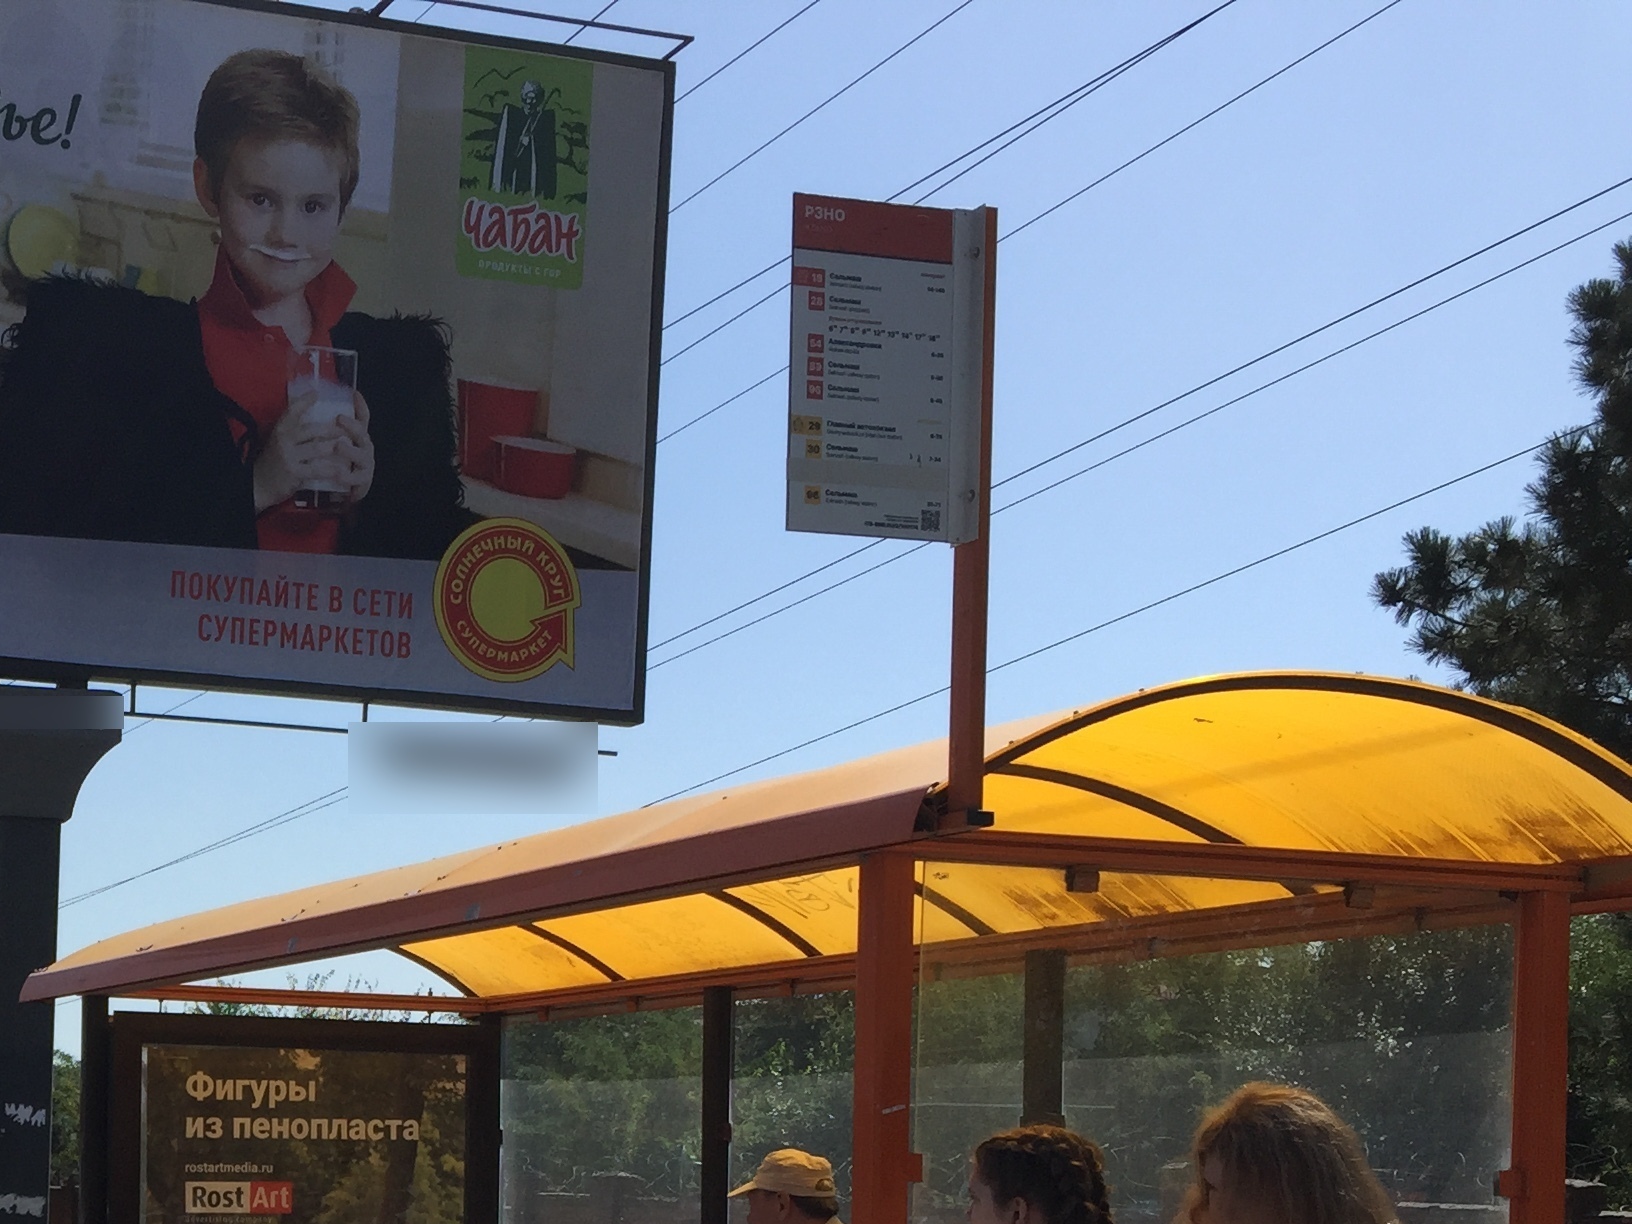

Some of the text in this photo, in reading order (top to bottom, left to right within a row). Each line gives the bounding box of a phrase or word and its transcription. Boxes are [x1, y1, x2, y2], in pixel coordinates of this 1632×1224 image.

[169, 570, 413, 620] ПОКУПАЙТЕ В СЕТИ
[535, 550, 565, 599] КРУГ
[197, 613, 412, 659] СУПЕРМАРКЕТОВ
[456, 620, 553, 663] СУПЕРМАРКЕТ
[185, 1070, 317, 1109] Фигуры
[185, 1116, 421, 1141] из пенопласта
[184, 1161, 274, 1174] rostartmedia.ru
